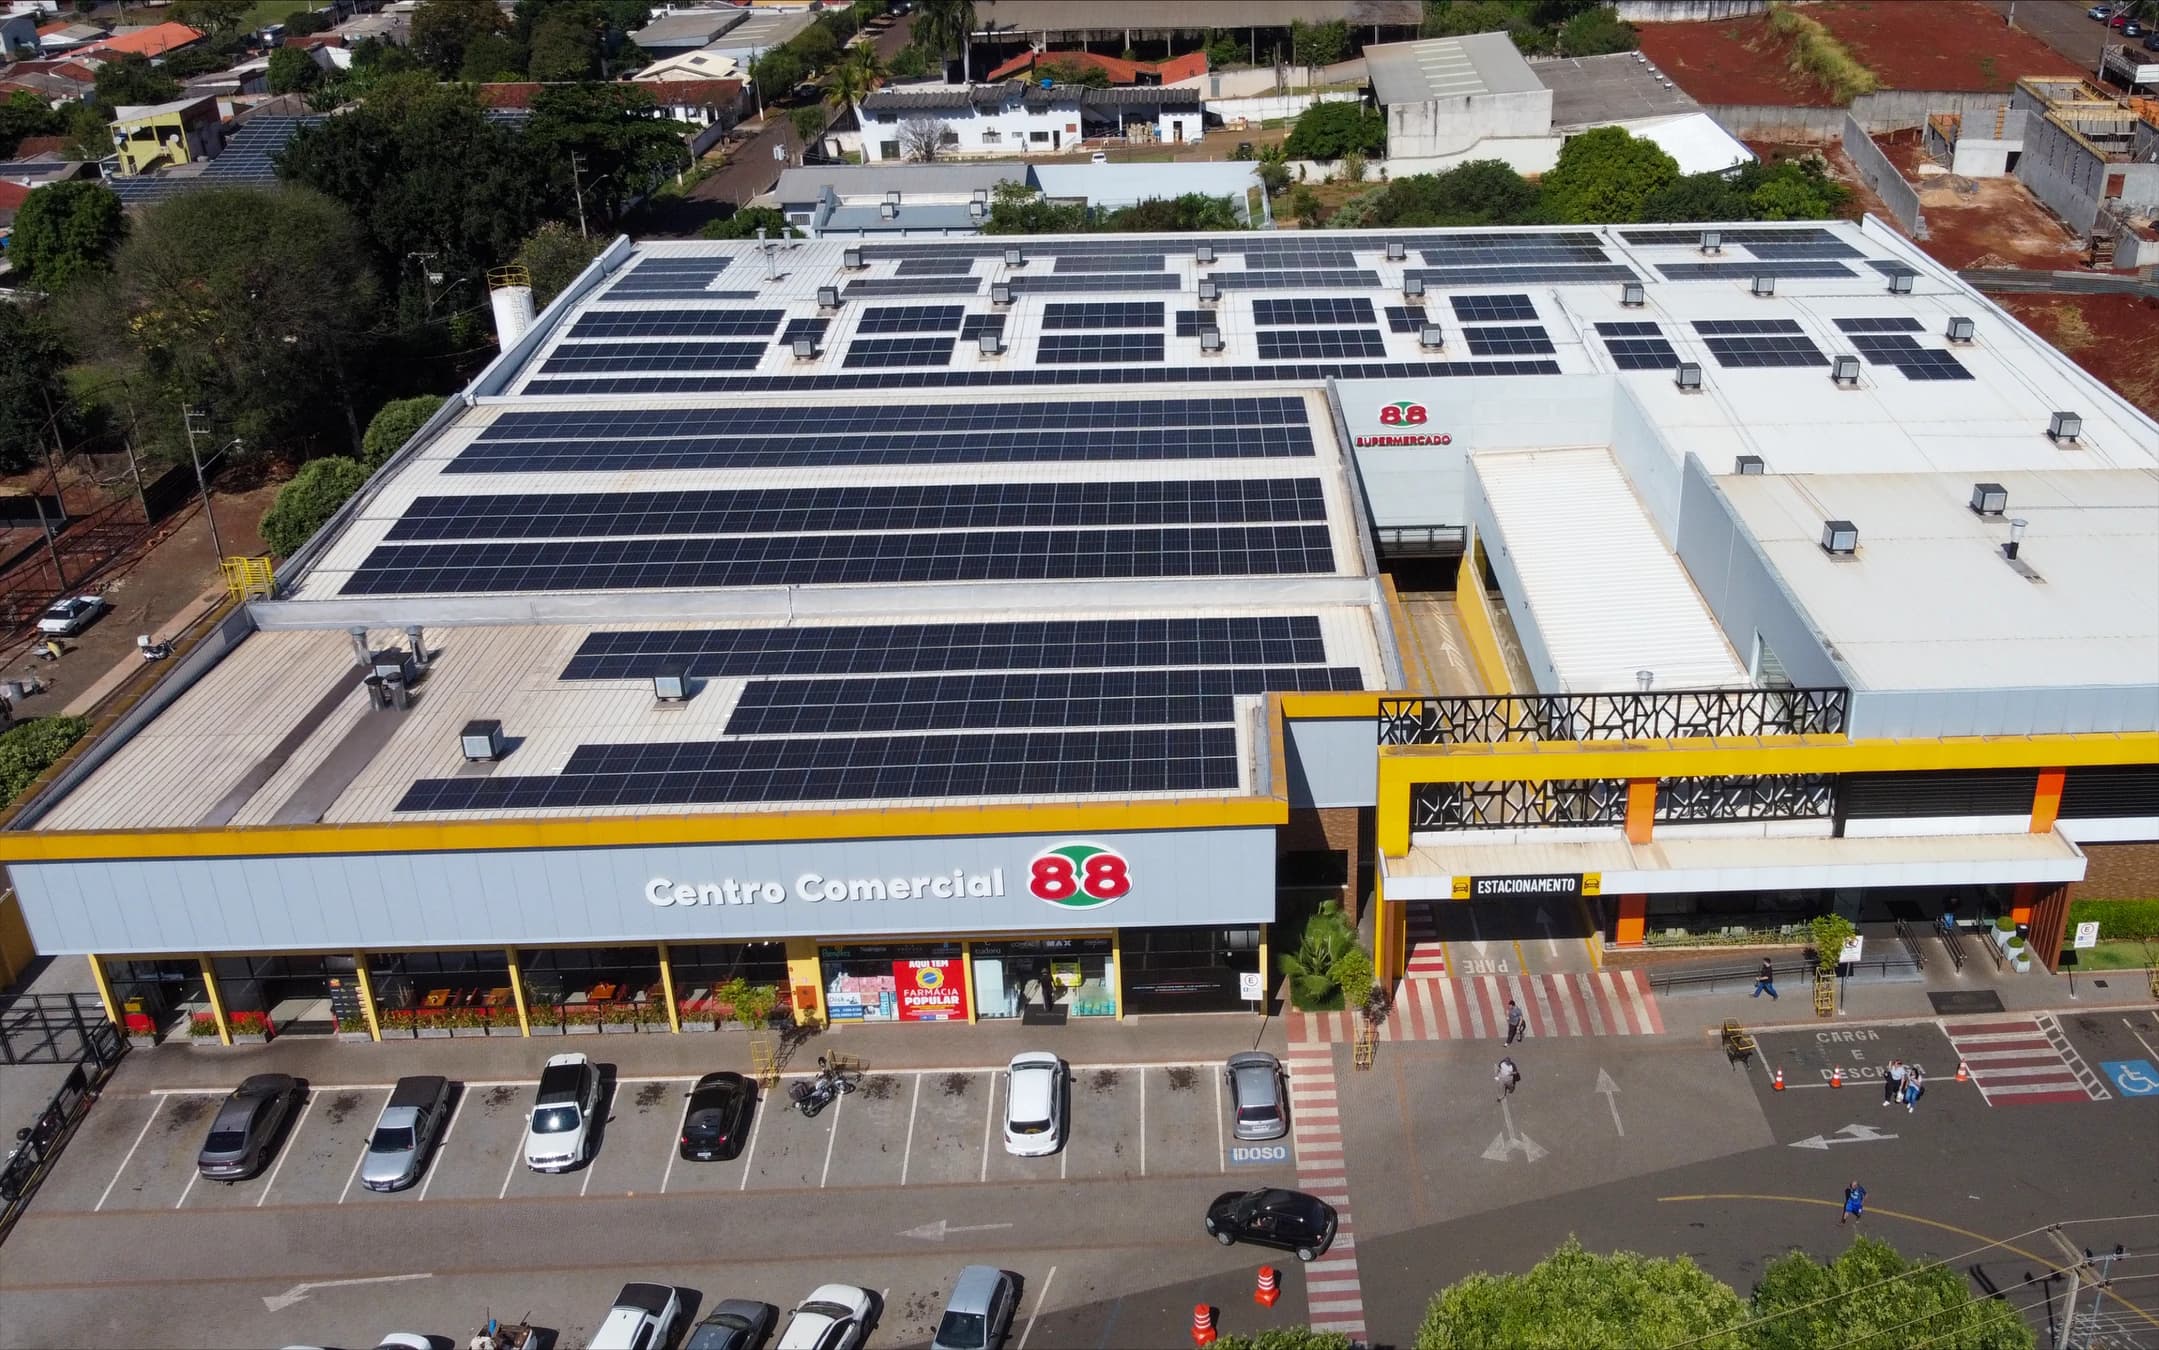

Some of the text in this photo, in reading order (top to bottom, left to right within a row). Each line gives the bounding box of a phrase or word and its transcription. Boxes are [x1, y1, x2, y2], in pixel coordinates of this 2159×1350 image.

[1379, 404, 1428, 425] 88
[1356, 434, 1453, 447] SUPERMERCADO
[645, 852, 1132, 907] Centro Comercial 88
[1477, 878, 1576, 894] ESTACIONAMENTO
[909, 960, 949, 968] AQUI TEM
[1462, 959, 1509, 974] PARE
[905, 996, 960, 1006] POPULAR
[1816, 1030, 1880, 1043] CARGA
[1851, 1049, 1865, 1060] E
[1232, 1146, 1286, 1161] IDOSO
